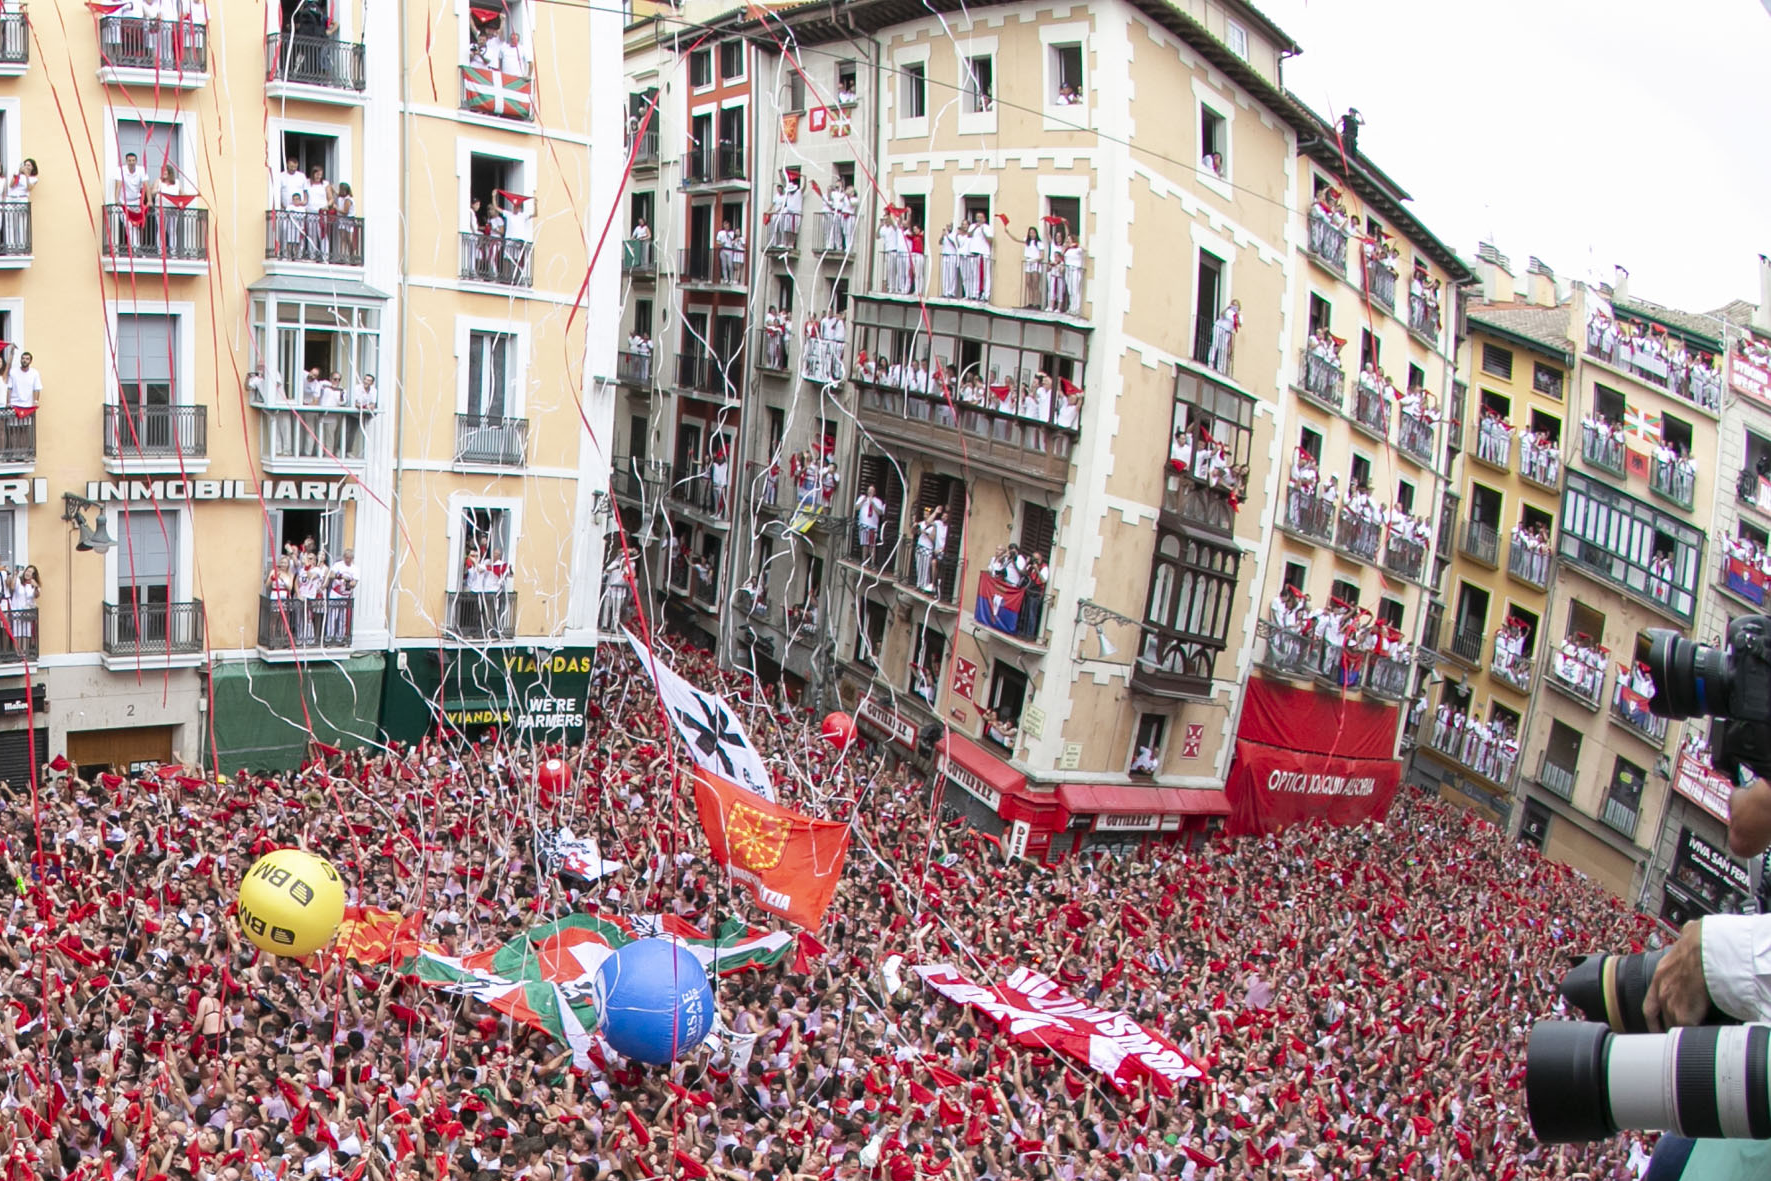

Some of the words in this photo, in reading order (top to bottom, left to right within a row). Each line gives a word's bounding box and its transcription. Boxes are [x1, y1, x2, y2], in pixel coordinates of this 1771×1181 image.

[86, 479, 363, 501] INMOBILIARIA
[126, 704, 135, 717] 2
[449, 709, 511, 724] VIANDAS
[517, 714, 583, 728] FARMERS
[947, 760, 993, 802] GUTIERREZ
[1268, 769, 1308, 794] OPTICA
[1105, 814, 1153, 827] GUTIERREZ
[1710, 848, 1731, 873] SAN
[253, 861, 292, 888] BM
[239, 900, 268, 937] BM
